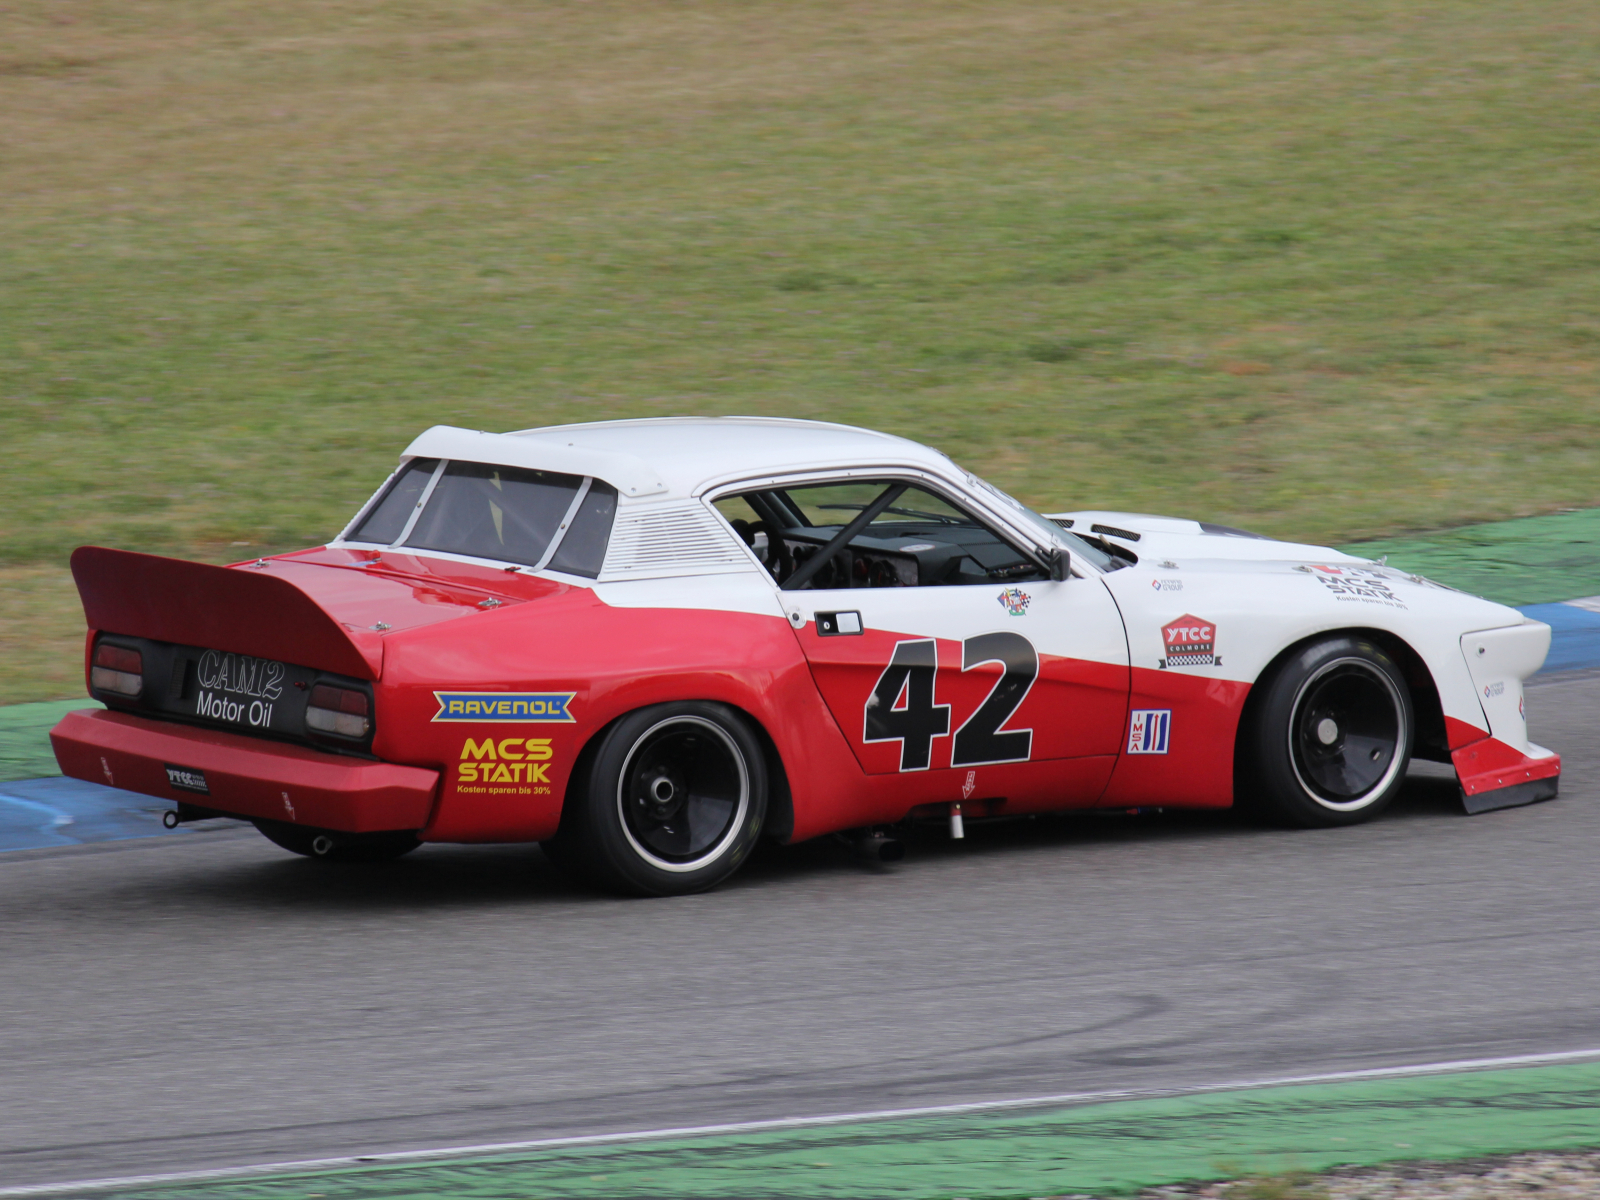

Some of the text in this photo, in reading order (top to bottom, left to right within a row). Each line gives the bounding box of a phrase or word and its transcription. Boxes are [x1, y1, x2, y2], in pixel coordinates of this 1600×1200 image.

[1316, 575, 1391, 591] MCS
[1326, 584, 1403, 603] STATIK
[1167, 626, 1211, 642] YTCC
[1170, 644, 1210, 652] COLMORE
[198, 648, 285, 700] CAM2
[196, 690, 273, 727] Motor Oil
[863, 629, 1040, 772] 42
[1131, 714, 1143, 751] IMSA
[460, 738, 553, 760] MCS
[458, 762, 551, 783] STATIK
[457, 785, 551, 795] Kosten sparen bis 30%
